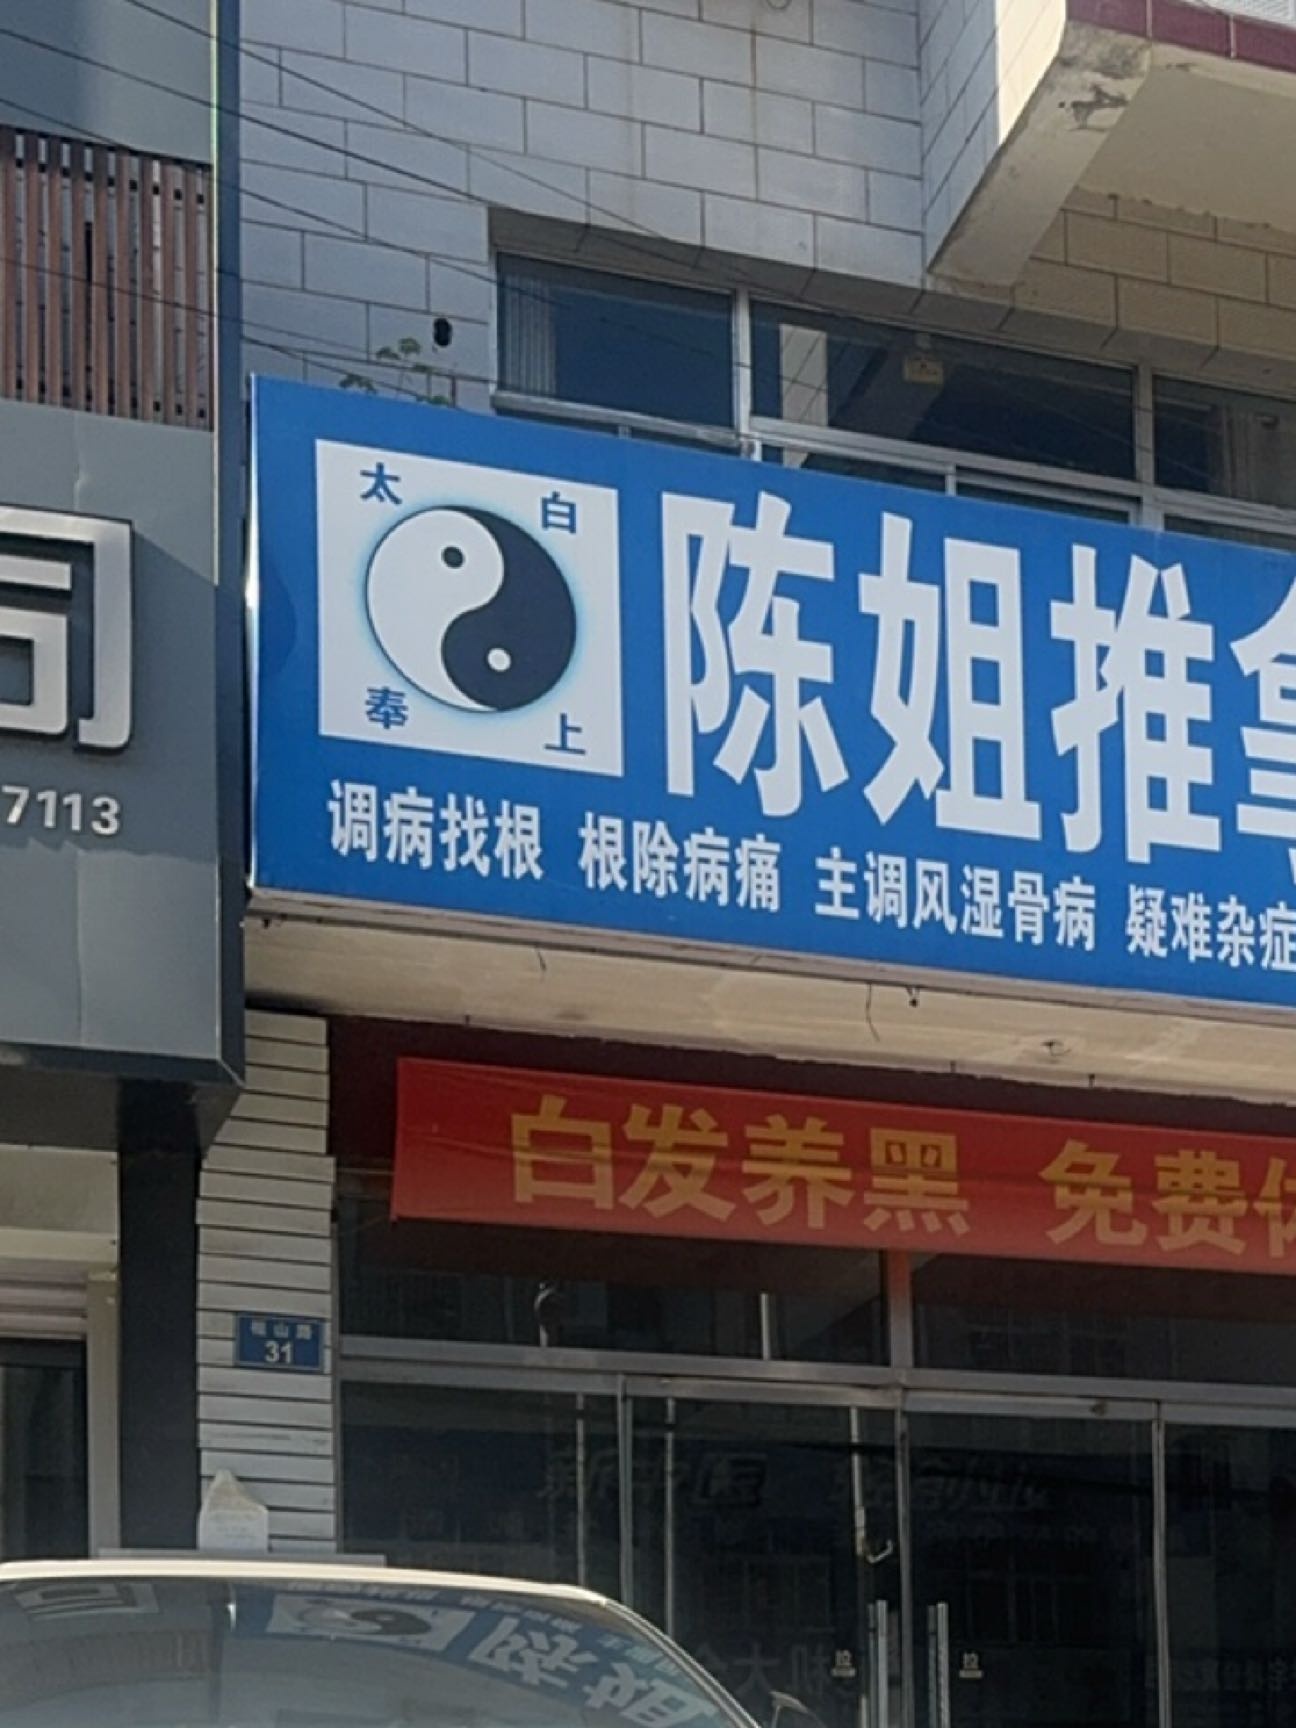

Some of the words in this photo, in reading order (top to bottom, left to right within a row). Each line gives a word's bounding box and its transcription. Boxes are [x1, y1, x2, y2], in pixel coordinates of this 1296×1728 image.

[360, 462, 402, 505] 太
[540, 491, 578, 535] 白
[365, 686, 408, 730] 奉
[545, 714, 585, 754] 上
[3, 786, 118, 834] 7113
[329, 781, 542, 878] 调病找根
[580, 812, 780, 911] 根除病痛
[816, 848, 1094, 950] 主调风湿骨病
[510, 1096, 972, 1236] 白发养黑
[264, 1341, 292, 1363] 31
